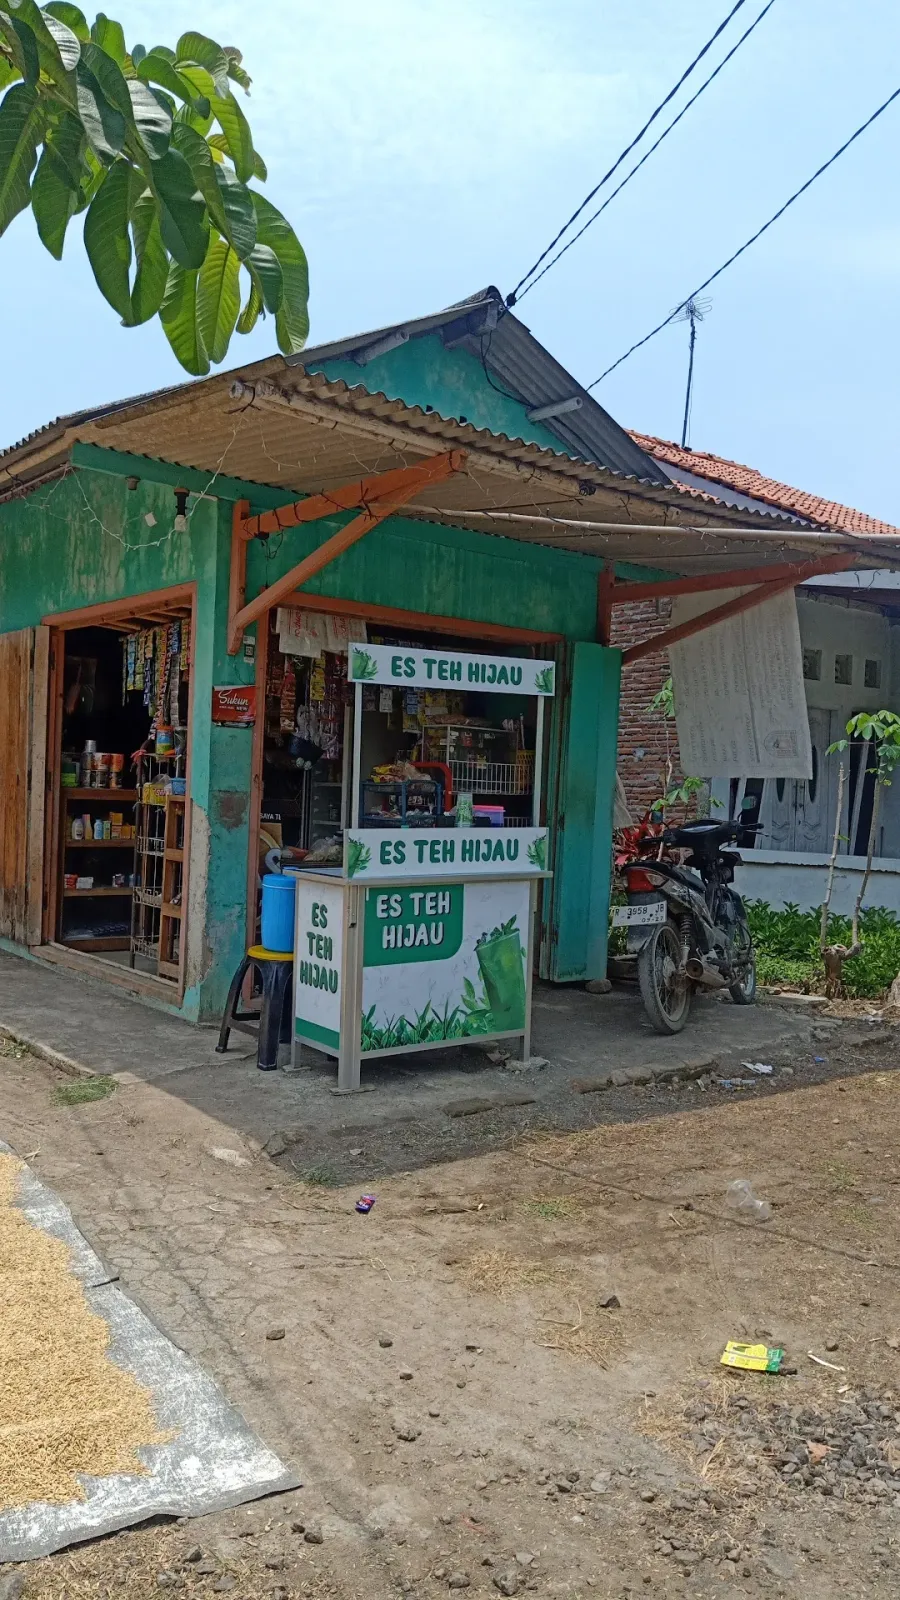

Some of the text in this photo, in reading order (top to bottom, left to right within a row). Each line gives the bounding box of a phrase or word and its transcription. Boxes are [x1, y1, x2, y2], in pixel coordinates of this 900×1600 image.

[391, 655, 522, 686] ES TEH HIJAU
[218, 689, 249, 706] Sukun
[379, 838, 519, 865] ES TEH HIJAU
[311, 902, 328, 929] ES
[376, 891, 451, 919] ES TEH
[306, 931, 333, 961] TEH
[382, 921, 444, 949] HIJAU
[300, 960, 338, 994] HIJAU
